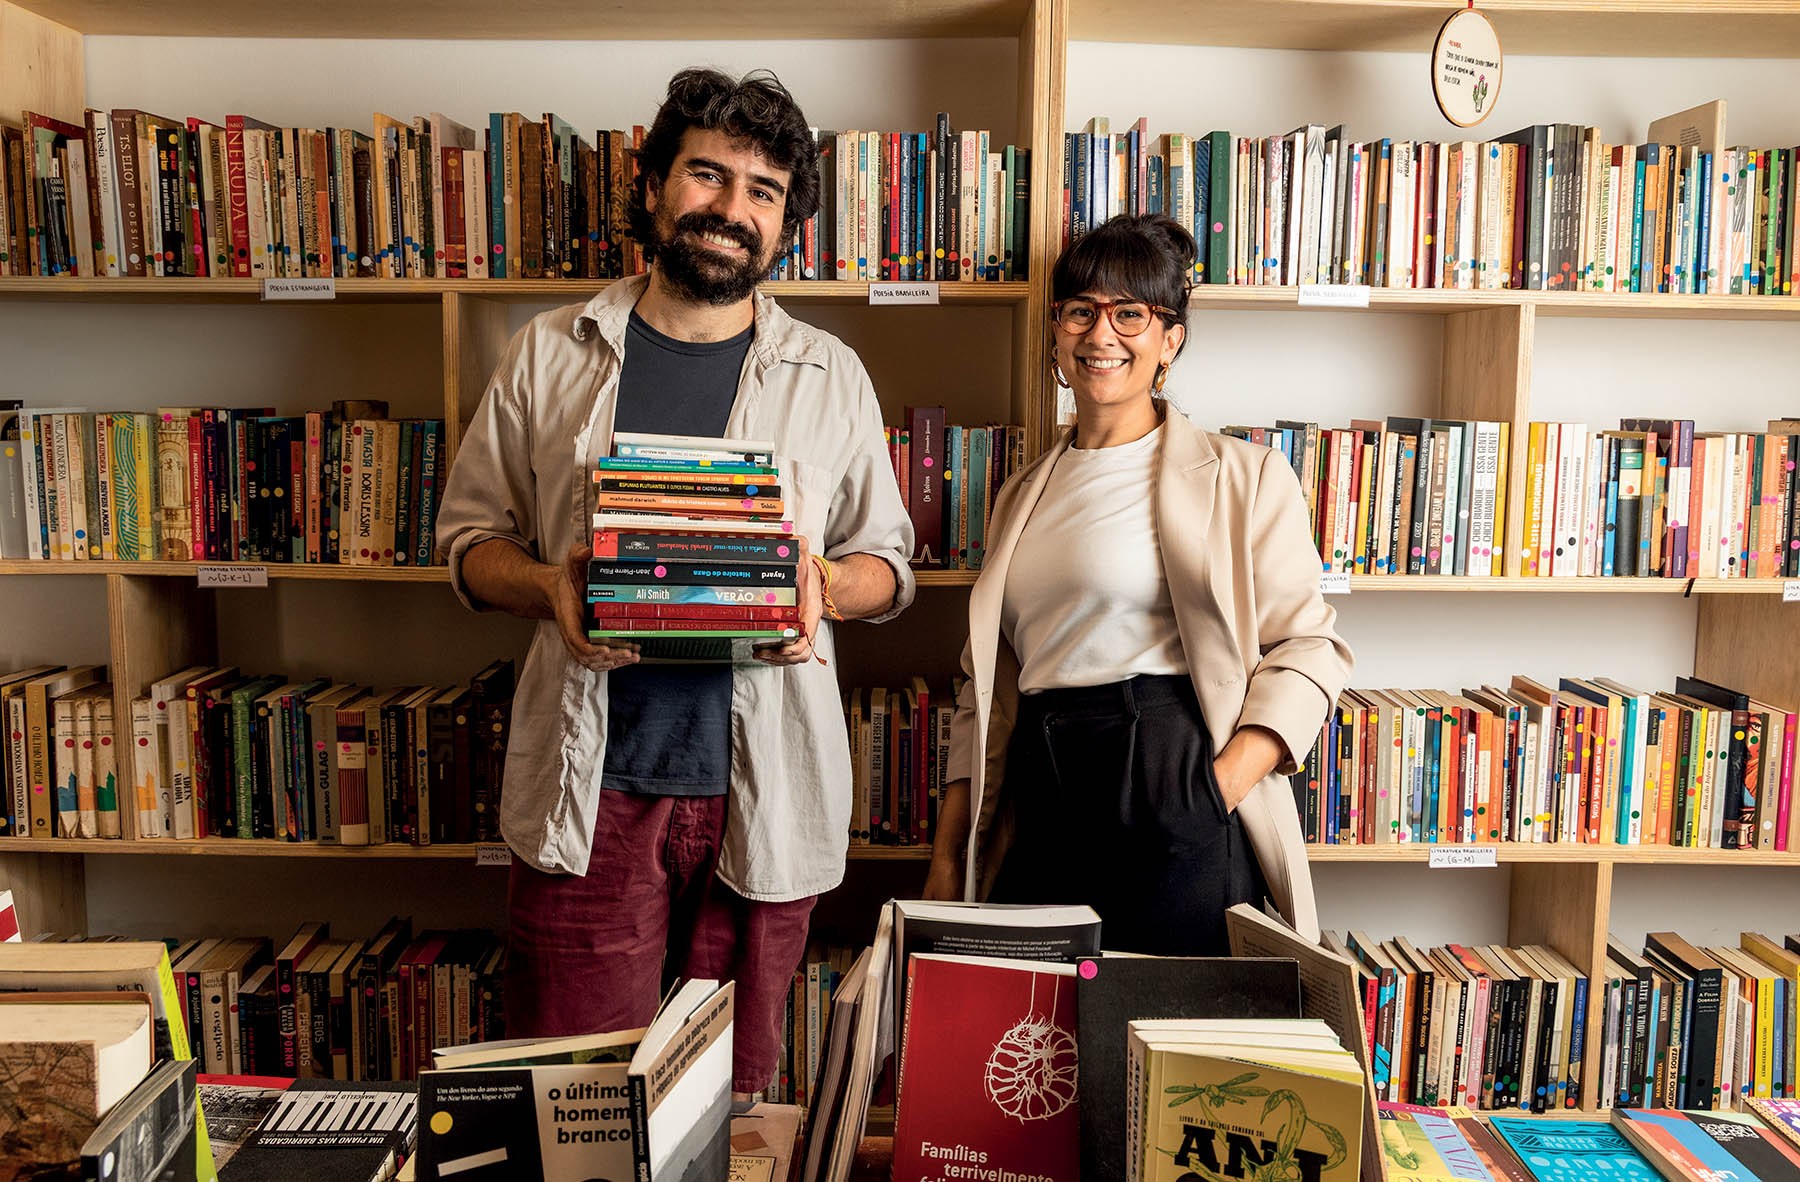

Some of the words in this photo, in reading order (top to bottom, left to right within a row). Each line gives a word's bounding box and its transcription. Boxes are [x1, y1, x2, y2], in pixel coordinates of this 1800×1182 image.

[97, 128, 106, 157] Poesia
[120, 135, 131, 152] T.S.
[1078, 134, 1086, 164] MANUEL
[121, 155, 134, 188] ELIOT
[228, 130, 247, 220] NERUDA
[128, 203, 139, 249] POESIA
[939, 236, 944, 244] UM
[873, 289, 894, 297] POESIA
[55, 420, 63, 444] MILAN
[1478, 432, 1487, 454] GENTE
[1488, 432, 1497, 454] GENTE
[424, 433, 436, 462] Levin
[46, 449, 54, 482] KUNDERA
[57, 445, 66, 480] KUNDERA
[424, 463, 433, 477] Ira
[1476, 455, 1485, 474] ESSA
[1487, 455, 1495, 474] ESSA
[361, 473, 372, 498] DORIS
[400, 466, 408, 497] Sabores
[924, 476, 932, 493] Noivos
[1533, 464, 1543, 517] DERRAMADO
[343, 483, 351, 512] Terrorista
[399, 498, 406, 509] do
[924, 494, 931, 502] Os
[1473, 489, 1484, 519] BUARQUE
[1484, 489, 1494, 519] BUARQUE
[48, 494, 57, 532] Brincadeira
[360, 503, 371, 537] LESSING
[422, 515, 429, 525] da
[420, 523, 429, 548] beijo
[1472, 519, 1481, 542] CHICO
[1483, 519, 1491, 542] CHICO
[1531, 519, 1539, 547] LEITE
[419, 549, 426, 557] O
[713, 544, 744, 552] beira-mar
[722, 570, 750, 578] Histoire
[636, 589, 647, 600] Ali
[648, 590, 670, 600] Smith
[715, 589, 754, 602] VERÃO
[873, 712, 882, 744] PAISAGENS
[942, 713, 950, 726] LEON
[941, 726, 950, 740] URIS
[33, 732, 42, 758] ÚLTIMO
[34, 760, 43, 784] HOMEM
[320, 751, 329, 788] GULAG
[873, 754, 881, 770] MEDO
[174, 773, 183, 805] VOLODIA
[18, 809, 24, 818] UM
[1424, 975, 1430, 984] no
[1421, 984, 1429, 1014] submundo
[1640, 981, 1648, 1001] ELITE
[1638, 1002, 1647, 1014] DA
[315, 1014, 324, 1043] FEIOS
[1421, 1016, 1426, 1024] do
[1636, 1015, 1645, 1038] TROPA
[300, 1012, 311, 1066] PERFEITOS
[284, 1034, 294, 1068] PORNO
[498, 1085, 523, 1093] segundo
[548, 1088, 561, 1101] o
[566, 1081, 631, 1100] último
[554, 1105, 631, 1123] homem
[258, 1136, 316, 1144] BARRICADAS
[557, 1127, 631, 1144] branco
[921, 1142, 988, 1164] Famílias
[944, 1163, 1054, 1182] terrivelmente
